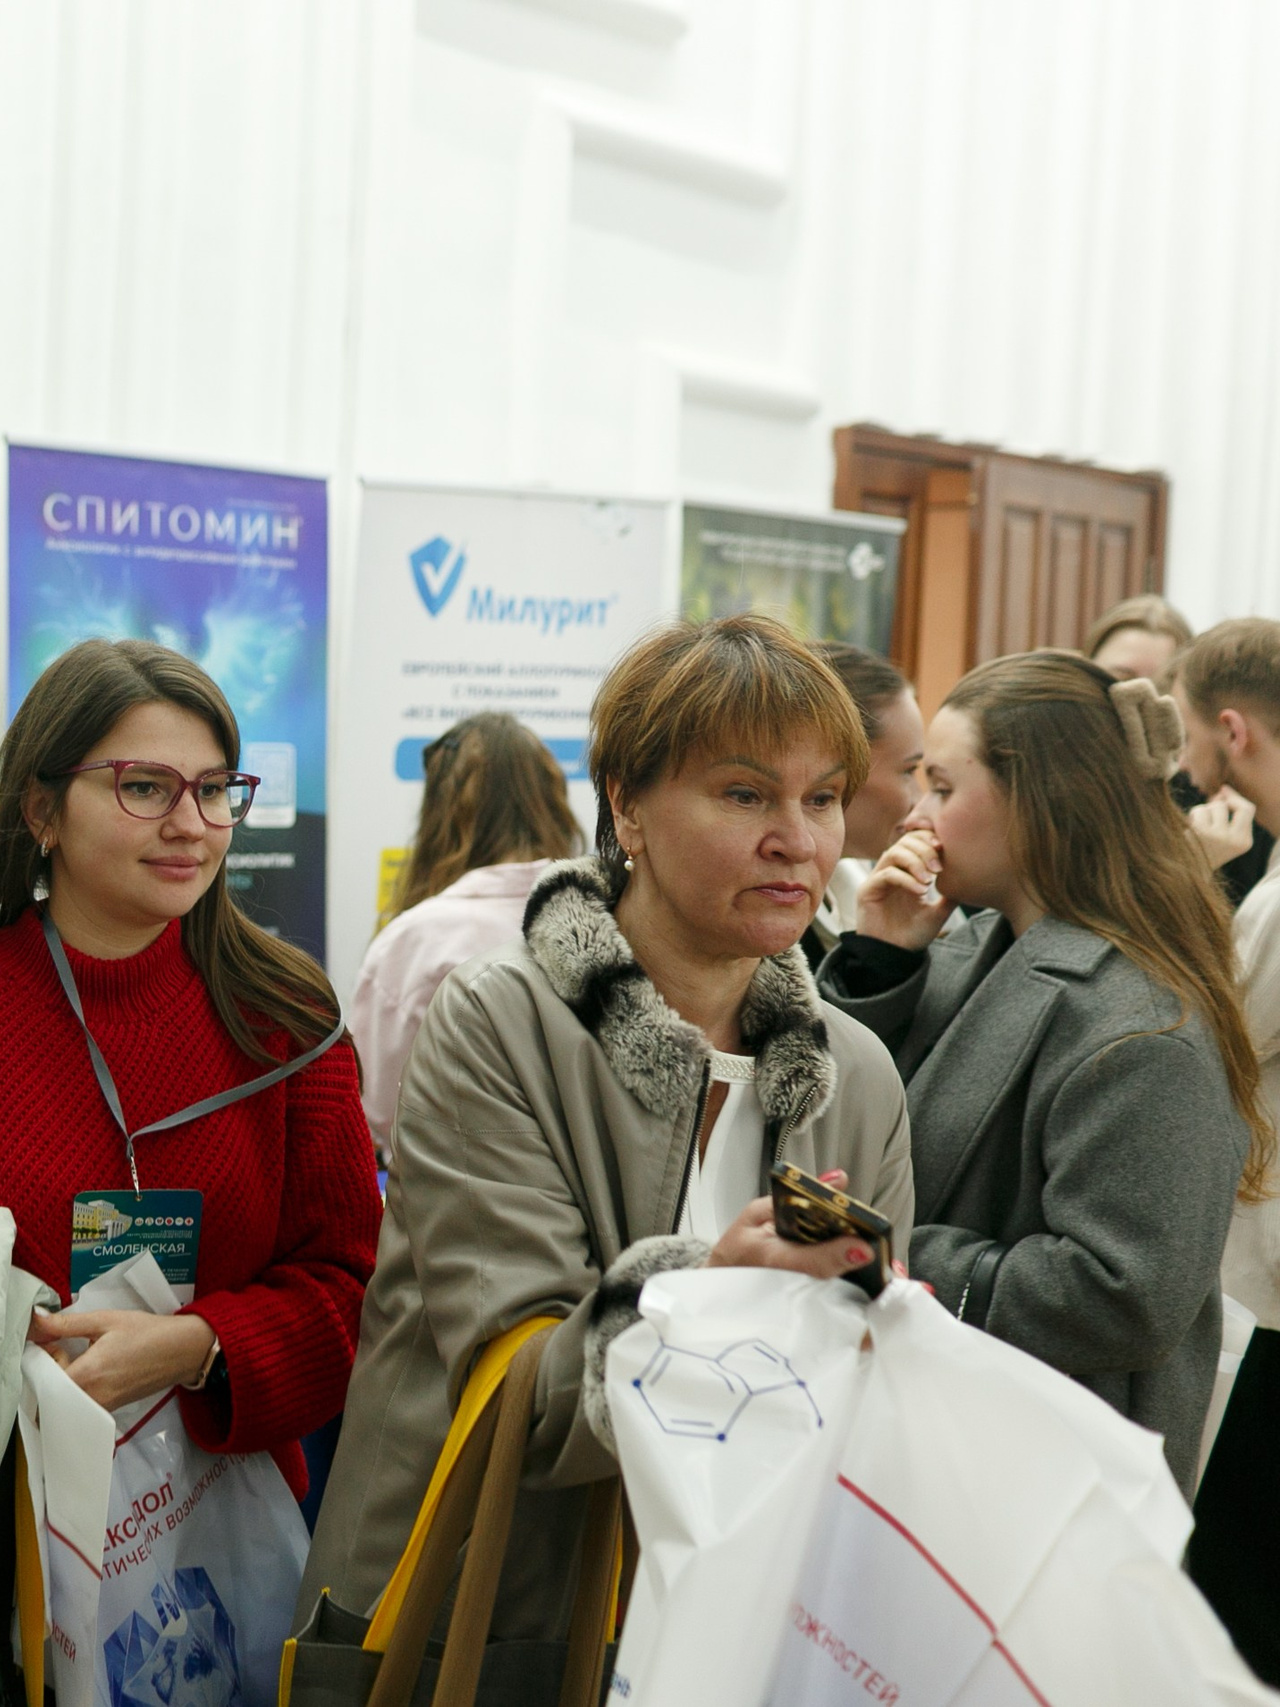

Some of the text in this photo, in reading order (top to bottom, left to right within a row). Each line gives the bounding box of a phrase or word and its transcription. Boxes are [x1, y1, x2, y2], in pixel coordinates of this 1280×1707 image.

[42, 492, 299, 550] СПИТОМИН
[467, 587, 607, 636] Милурит
[791, 1602, 899, 1707] ОЖНОСТЕЙ
